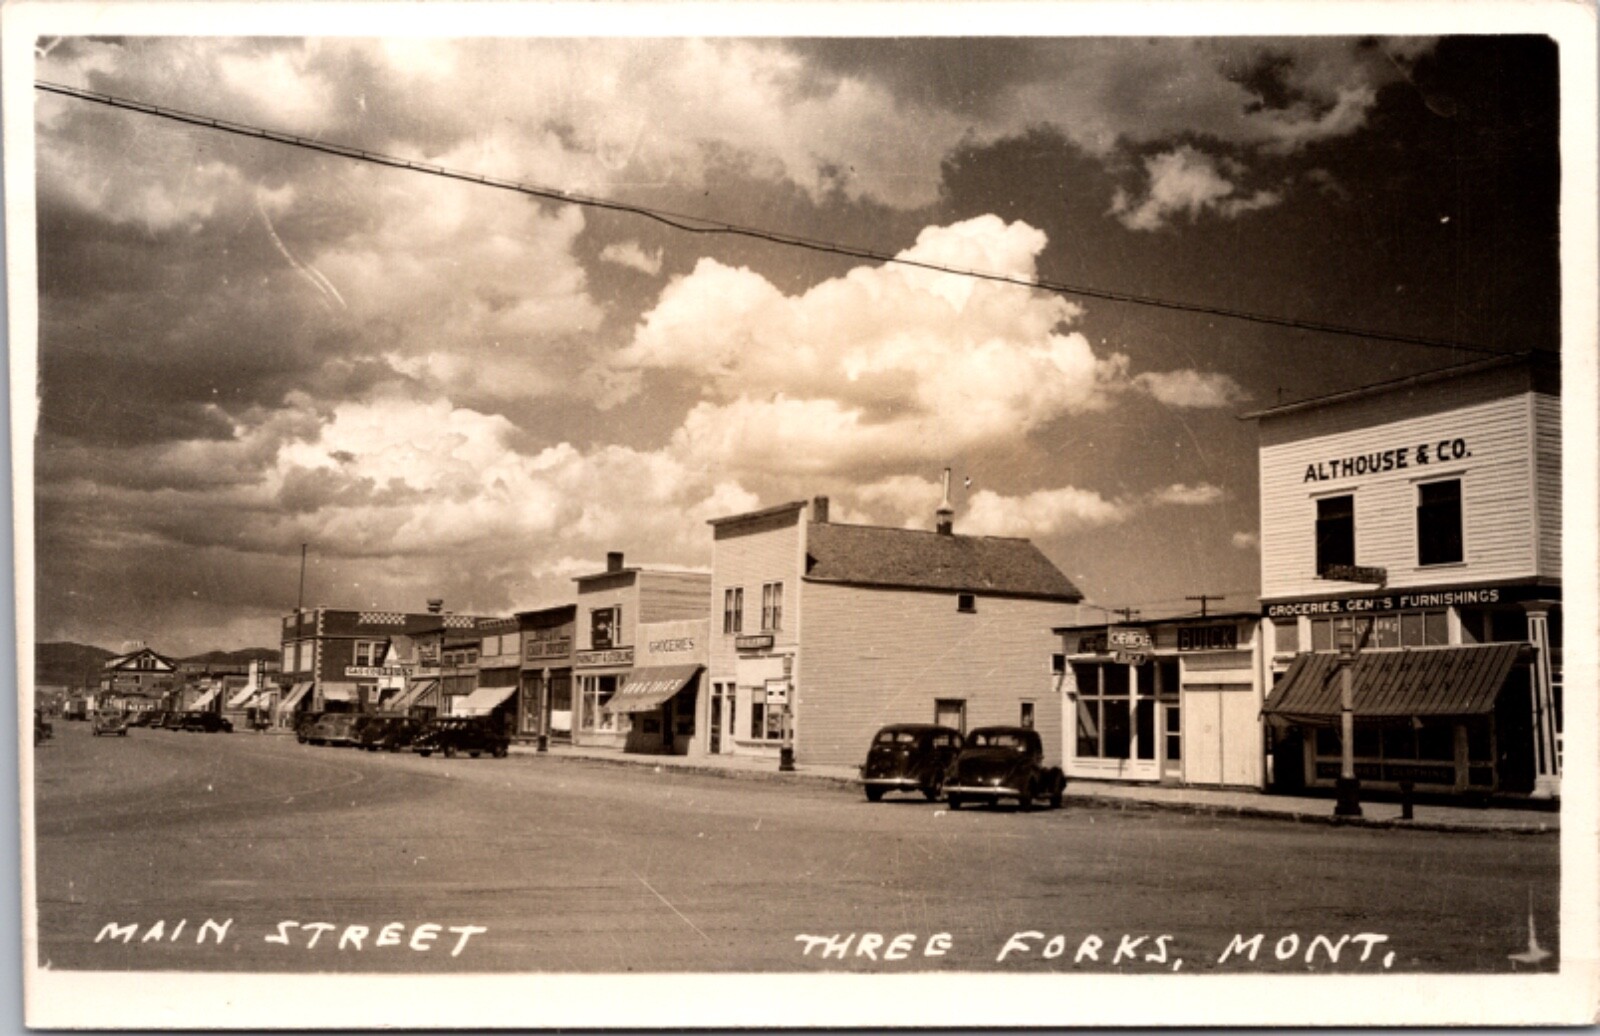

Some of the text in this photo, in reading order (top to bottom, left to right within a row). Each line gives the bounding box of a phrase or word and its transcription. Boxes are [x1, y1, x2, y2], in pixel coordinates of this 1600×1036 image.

[1304, 437, 1473, 484] ALTHOUSE & CO.
[1400, 588, 1500, 608] FURNISHINGS
[649, 636, 696, 654] GROCERIES
